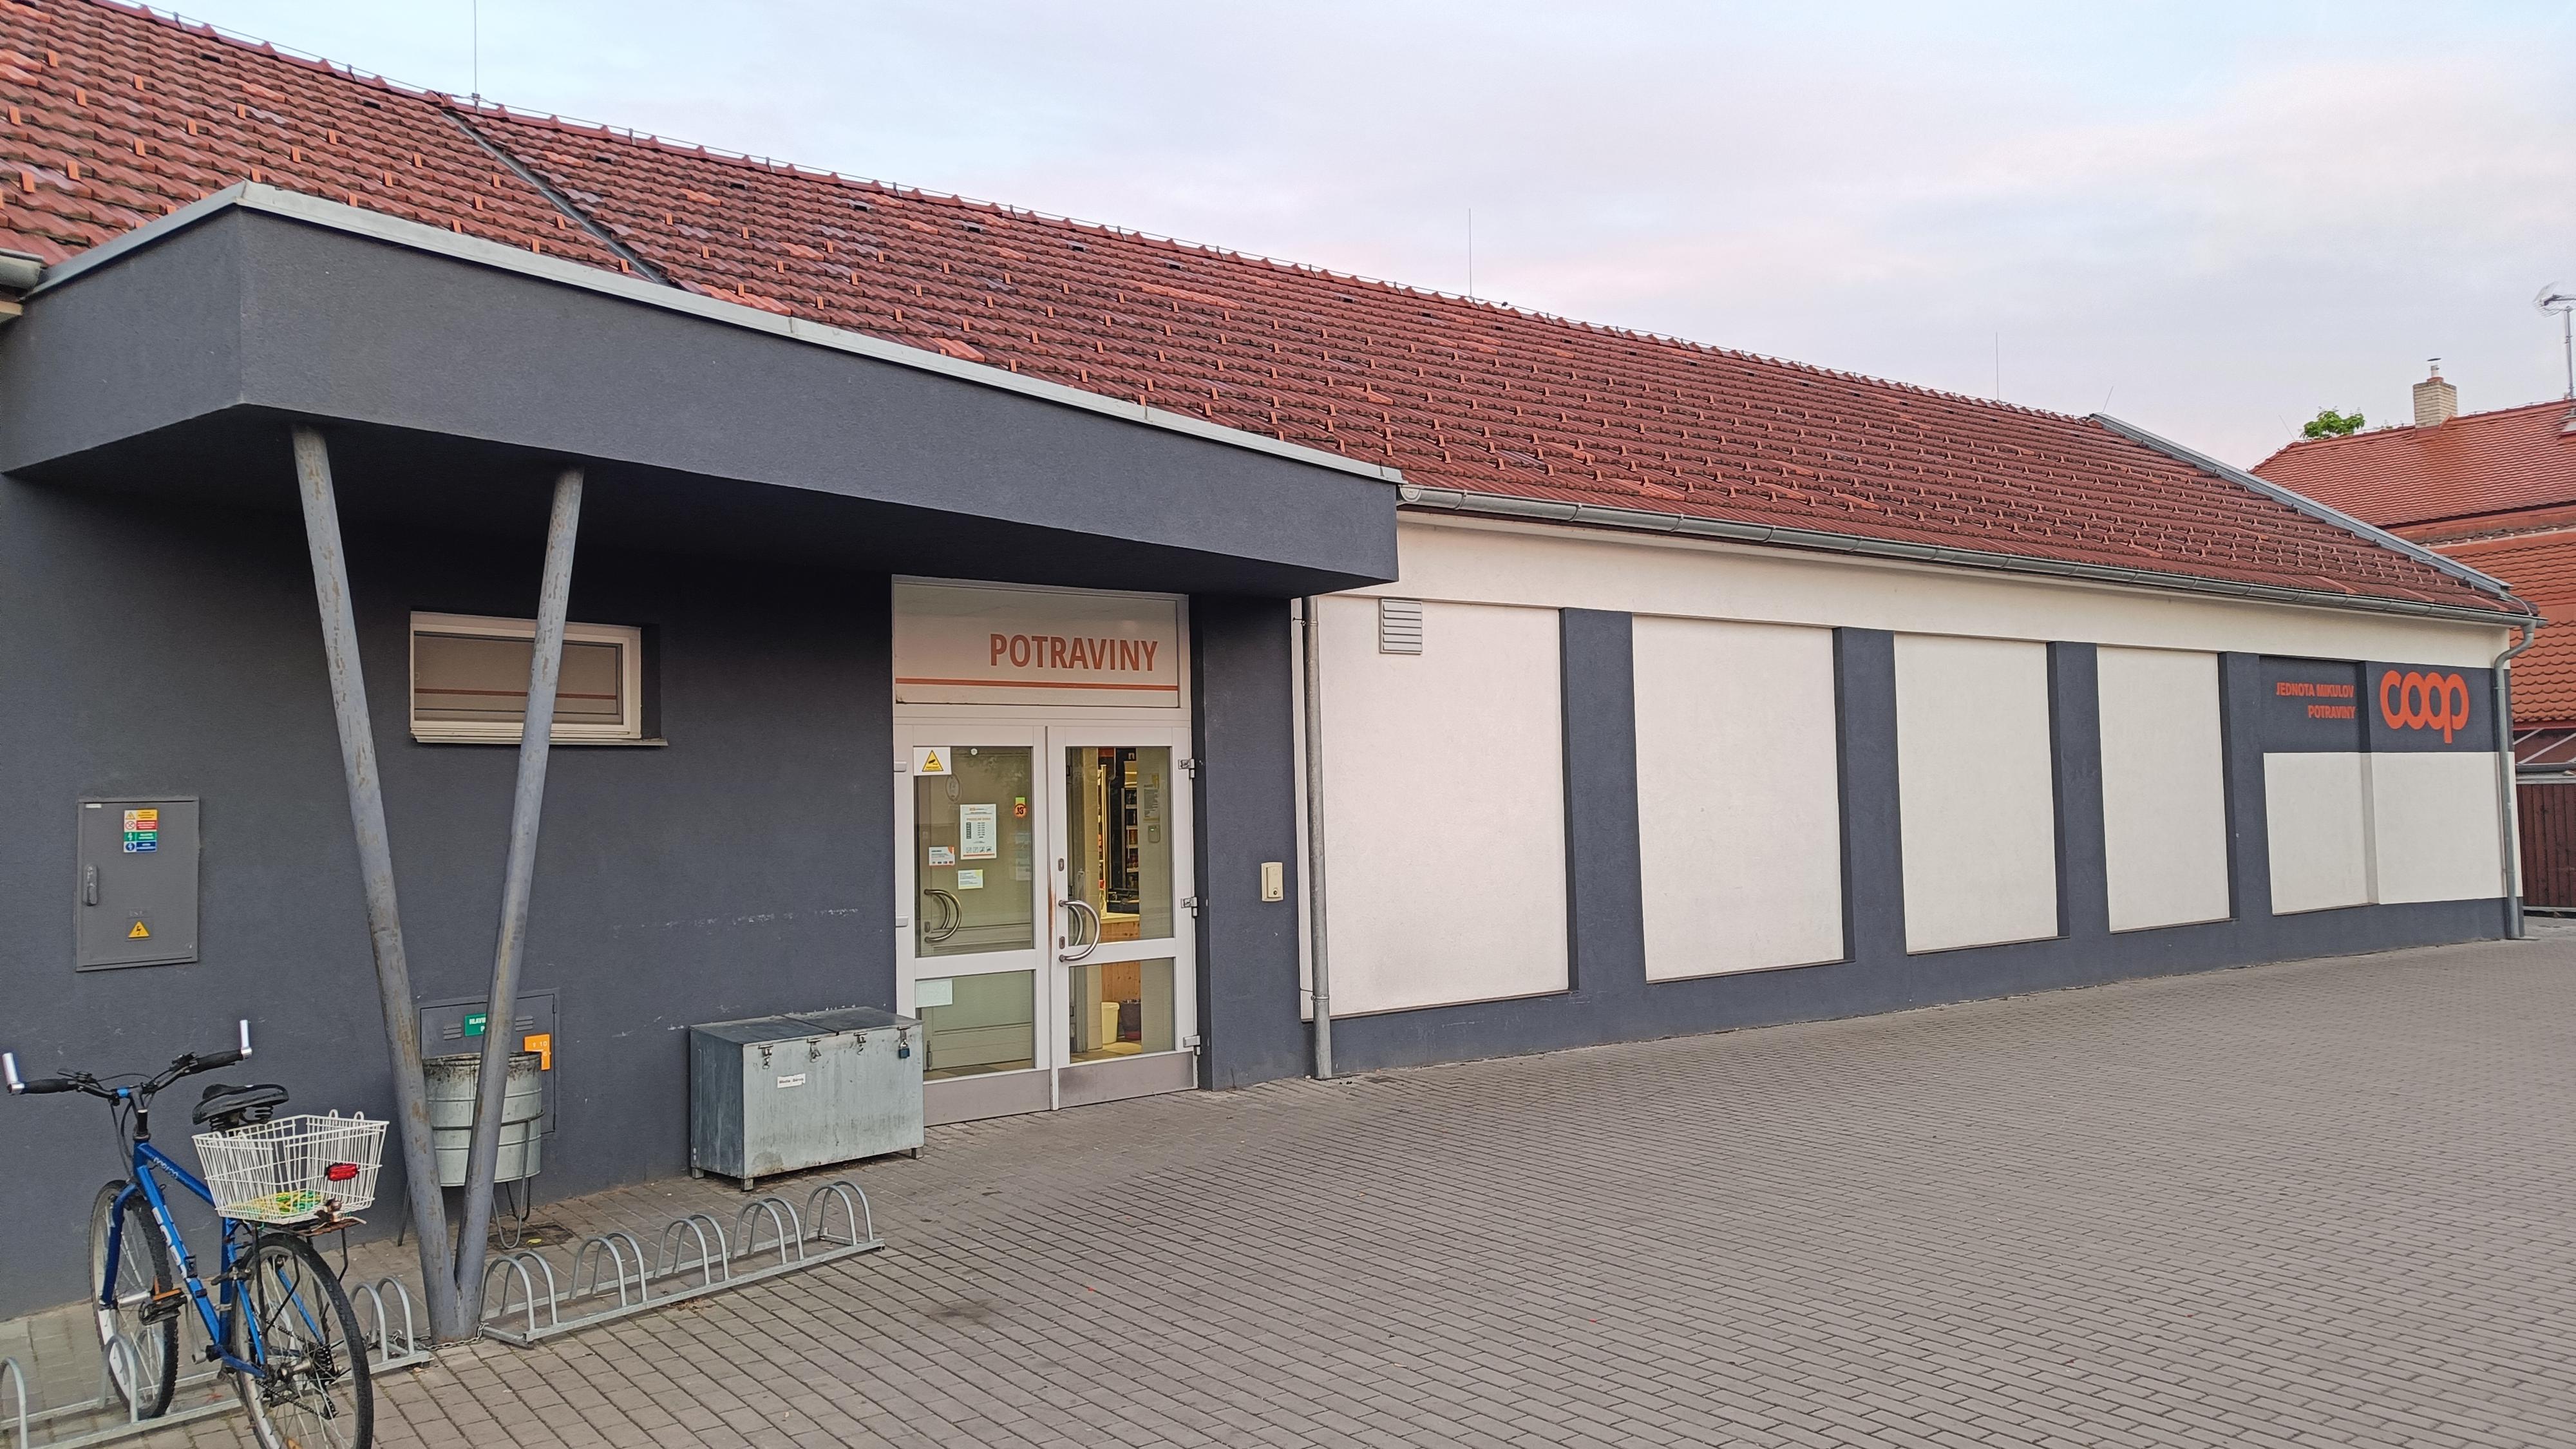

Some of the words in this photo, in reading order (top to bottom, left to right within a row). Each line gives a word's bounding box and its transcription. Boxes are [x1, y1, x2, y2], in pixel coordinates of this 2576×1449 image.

[990, 633, 1158, 672] POTRAVINY
[2276, 682, 2315, 697] JEDNOTA
[2316, 684, 2354, 698] MIKULOV
[2308, 705, 2356, 719] POTRAVINY
